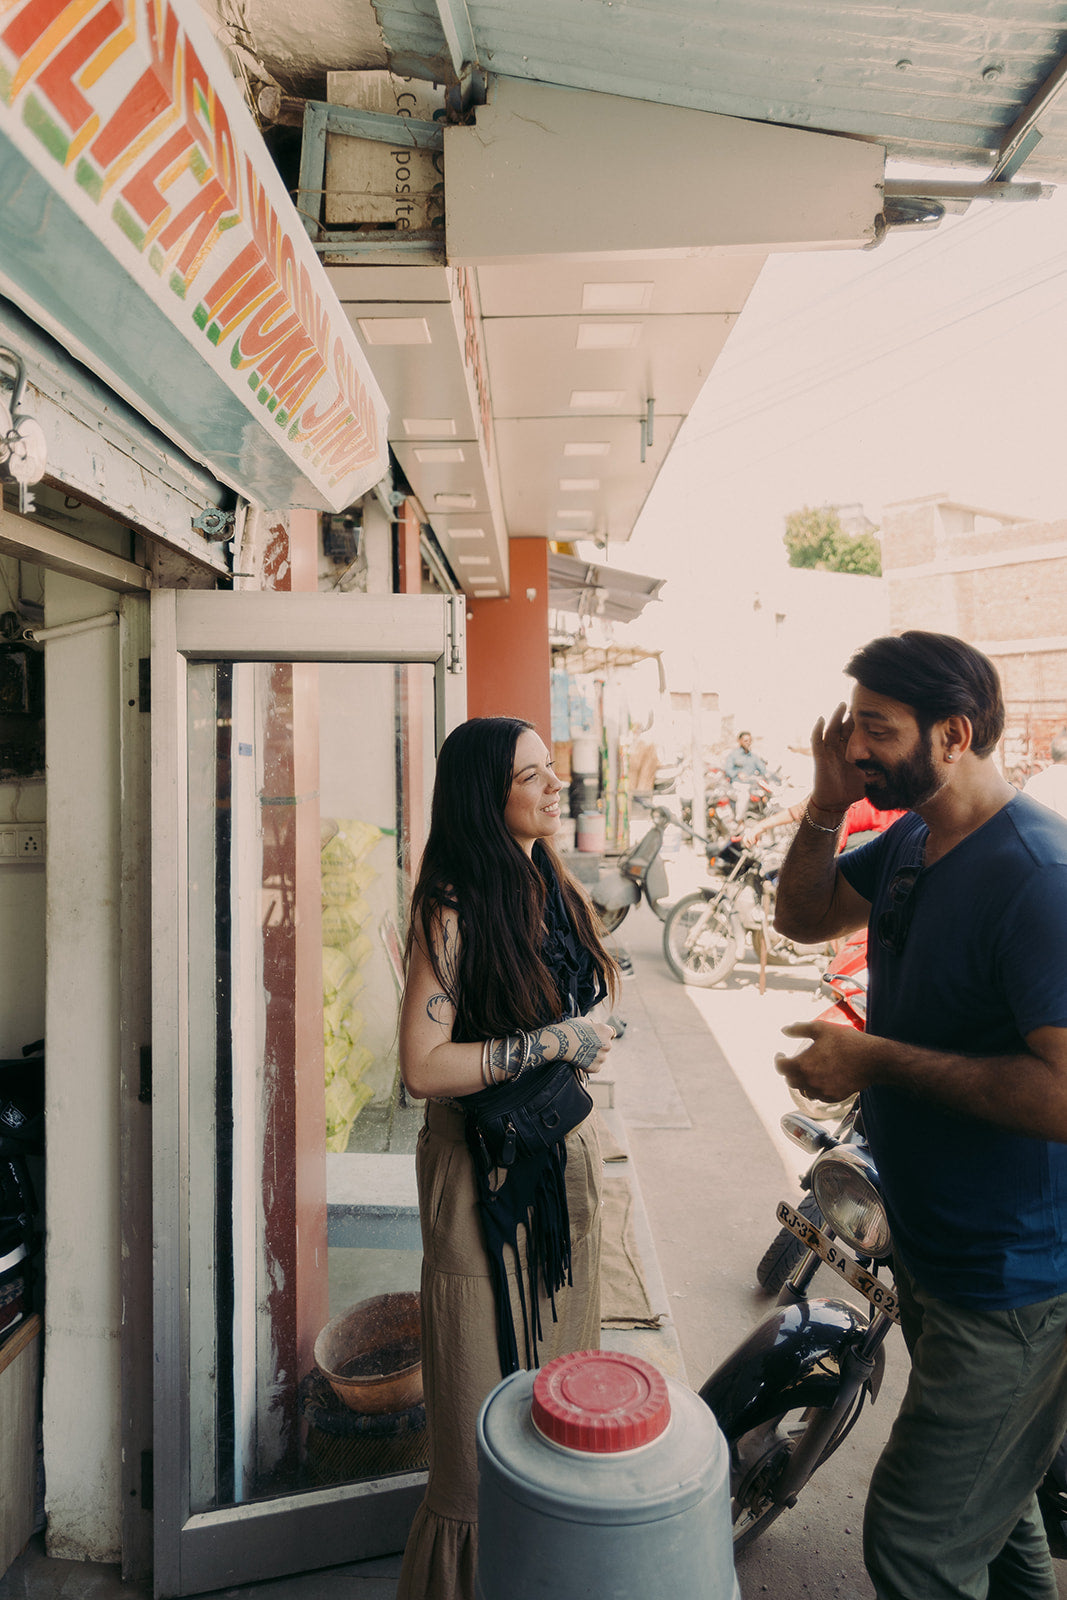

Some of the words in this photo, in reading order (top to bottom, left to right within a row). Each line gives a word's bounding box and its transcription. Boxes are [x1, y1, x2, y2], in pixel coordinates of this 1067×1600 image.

[192, 153, 331, 428] WORK
[288, 337, 379, 486] SHOP
[826, 1248, 846, 1273] SA
